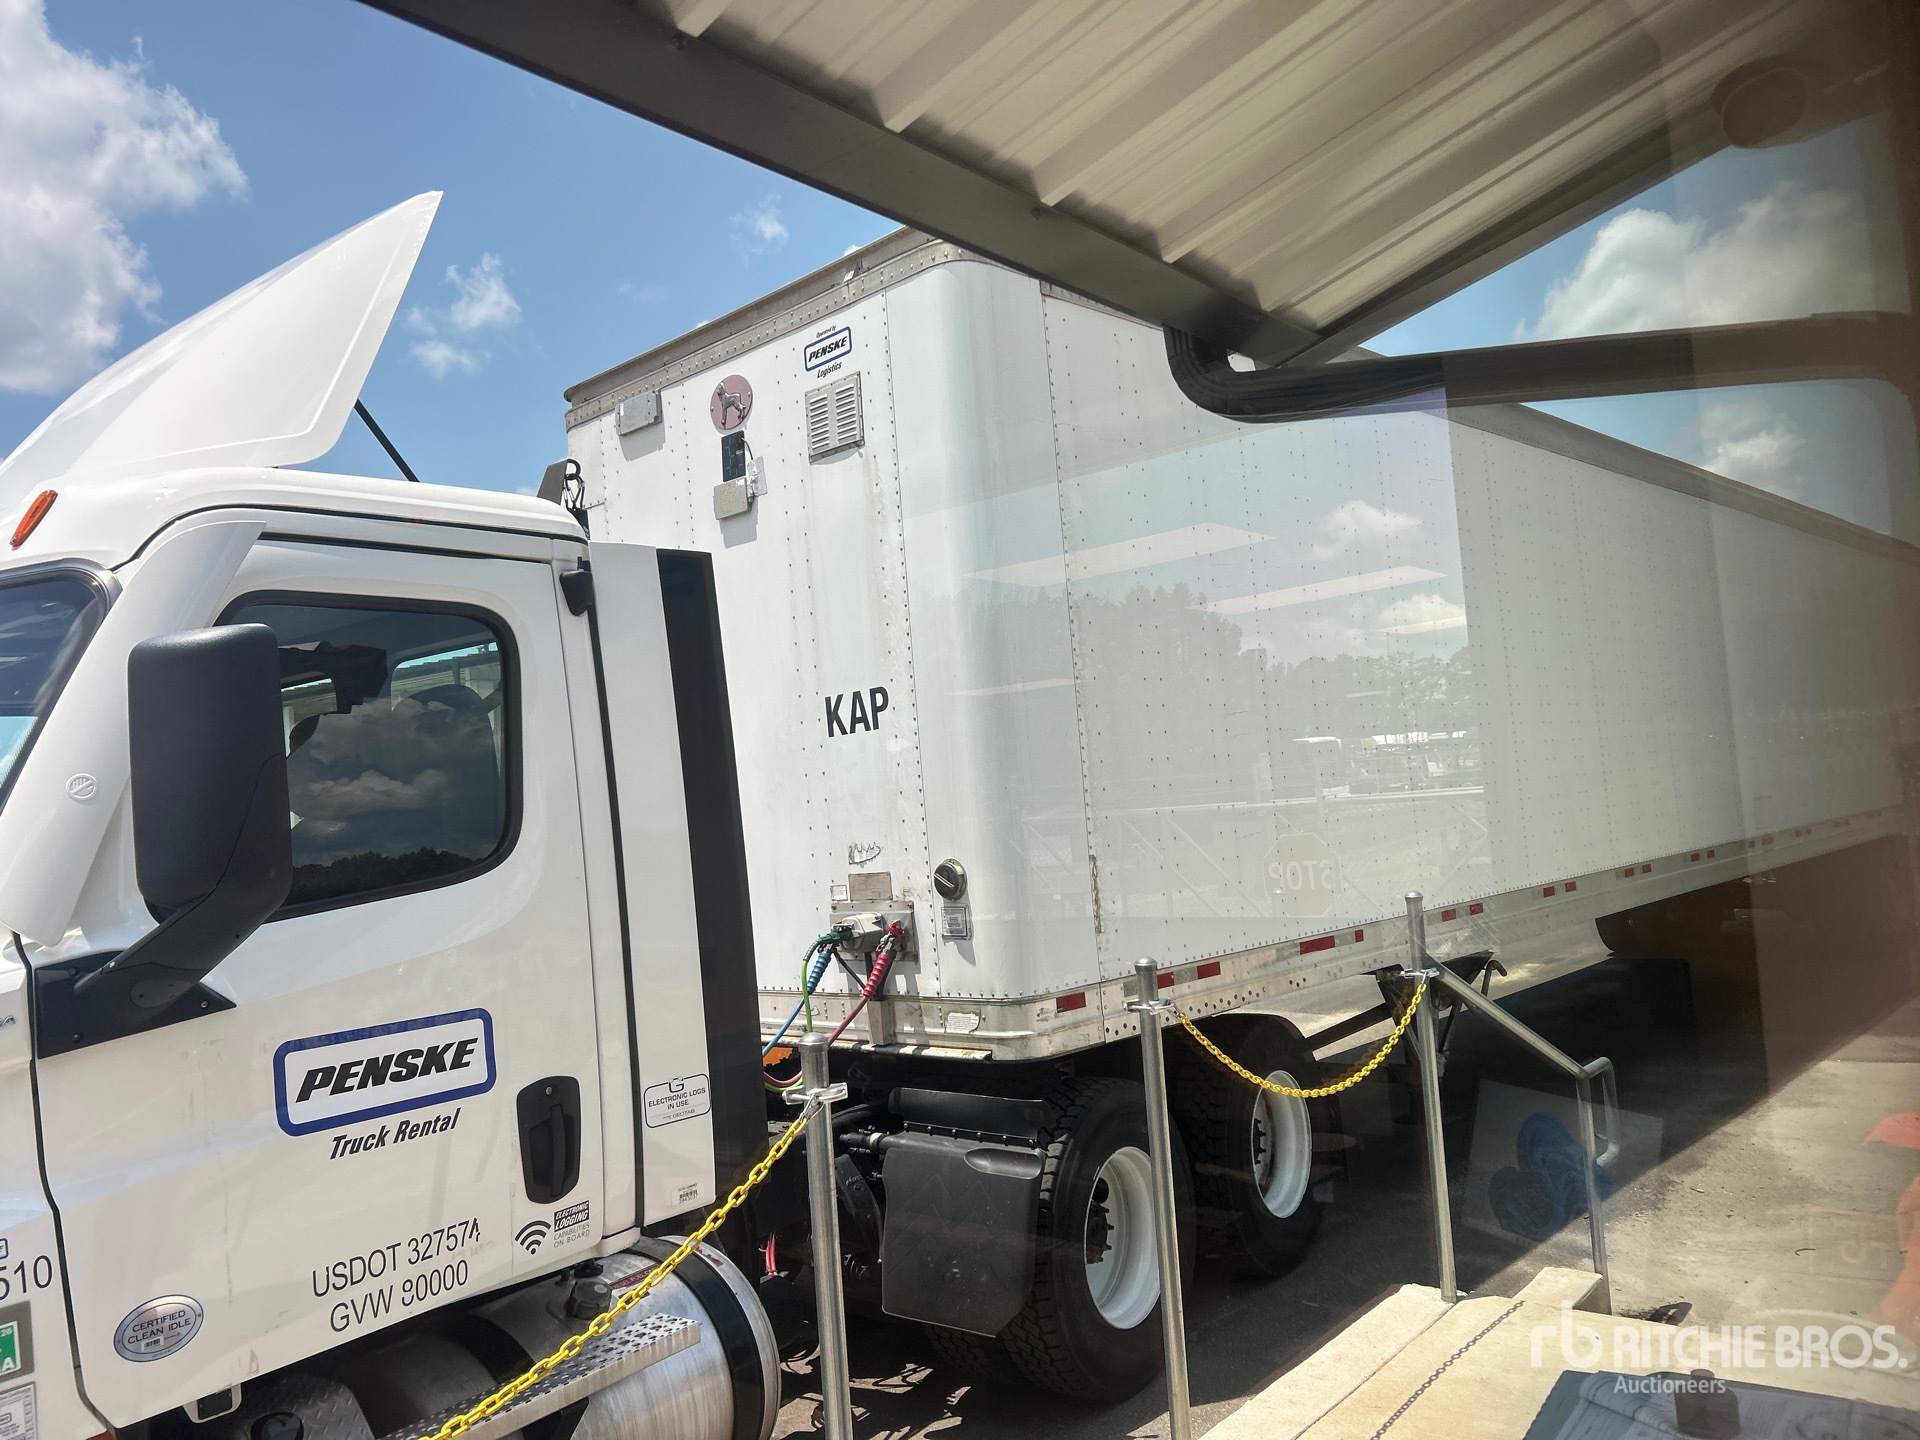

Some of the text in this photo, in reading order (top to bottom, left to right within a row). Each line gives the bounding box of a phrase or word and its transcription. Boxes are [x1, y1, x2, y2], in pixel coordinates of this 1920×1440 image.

[808, 336, 847, 362] PENSKE
[817, 361, 842, 378] Logistics
[824, 686, 890, 738] KAP
[295, 1037, 479, 1103] PENSKE
[648, 1087, 706, 1108] ELECTRONIC LOGS
[675, 1099, 689, 1108] USE
[330, 1107, 461, 1160] Truck Rental
[555, 1201, 590, 1220] ELECTRONIC
[555, 1209, 590, 1230] LOGGING
[553, 1222, 590, 1240] CAPABILITIES
[554, 1229, 590, 1248] ON BOARD
[312, 1242, 401, 1297] USDOT
[330, 1259, 469, 1332] GVW 80000
[127, 1327, 164, 1344] CLEAN
[168, 1318, 192, 1332] IDLE
[132, 1309, 186, 1333] CERTIFIED
